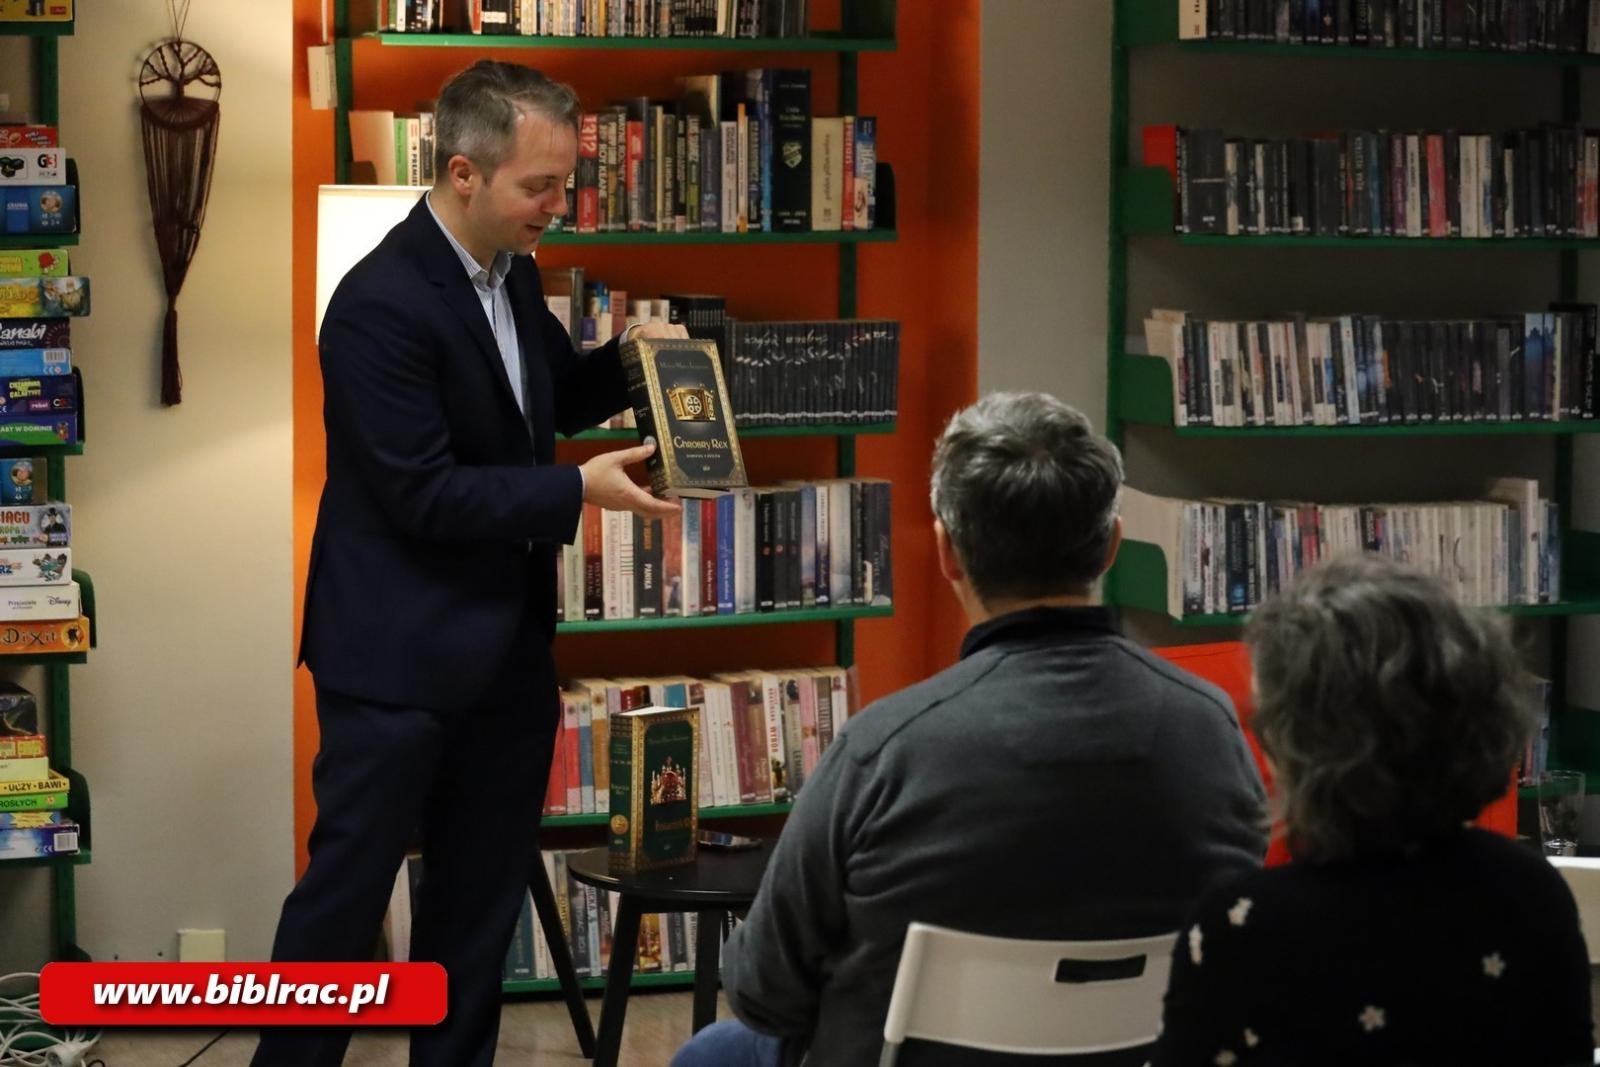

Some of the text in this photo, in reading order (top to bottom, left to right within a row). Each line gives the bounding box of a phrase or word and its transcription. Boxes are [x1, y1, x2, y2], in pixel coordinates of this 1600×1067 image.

[581, 115, 597, 153] 1312
[9, 781, 62, 791] UCZY BAWI
